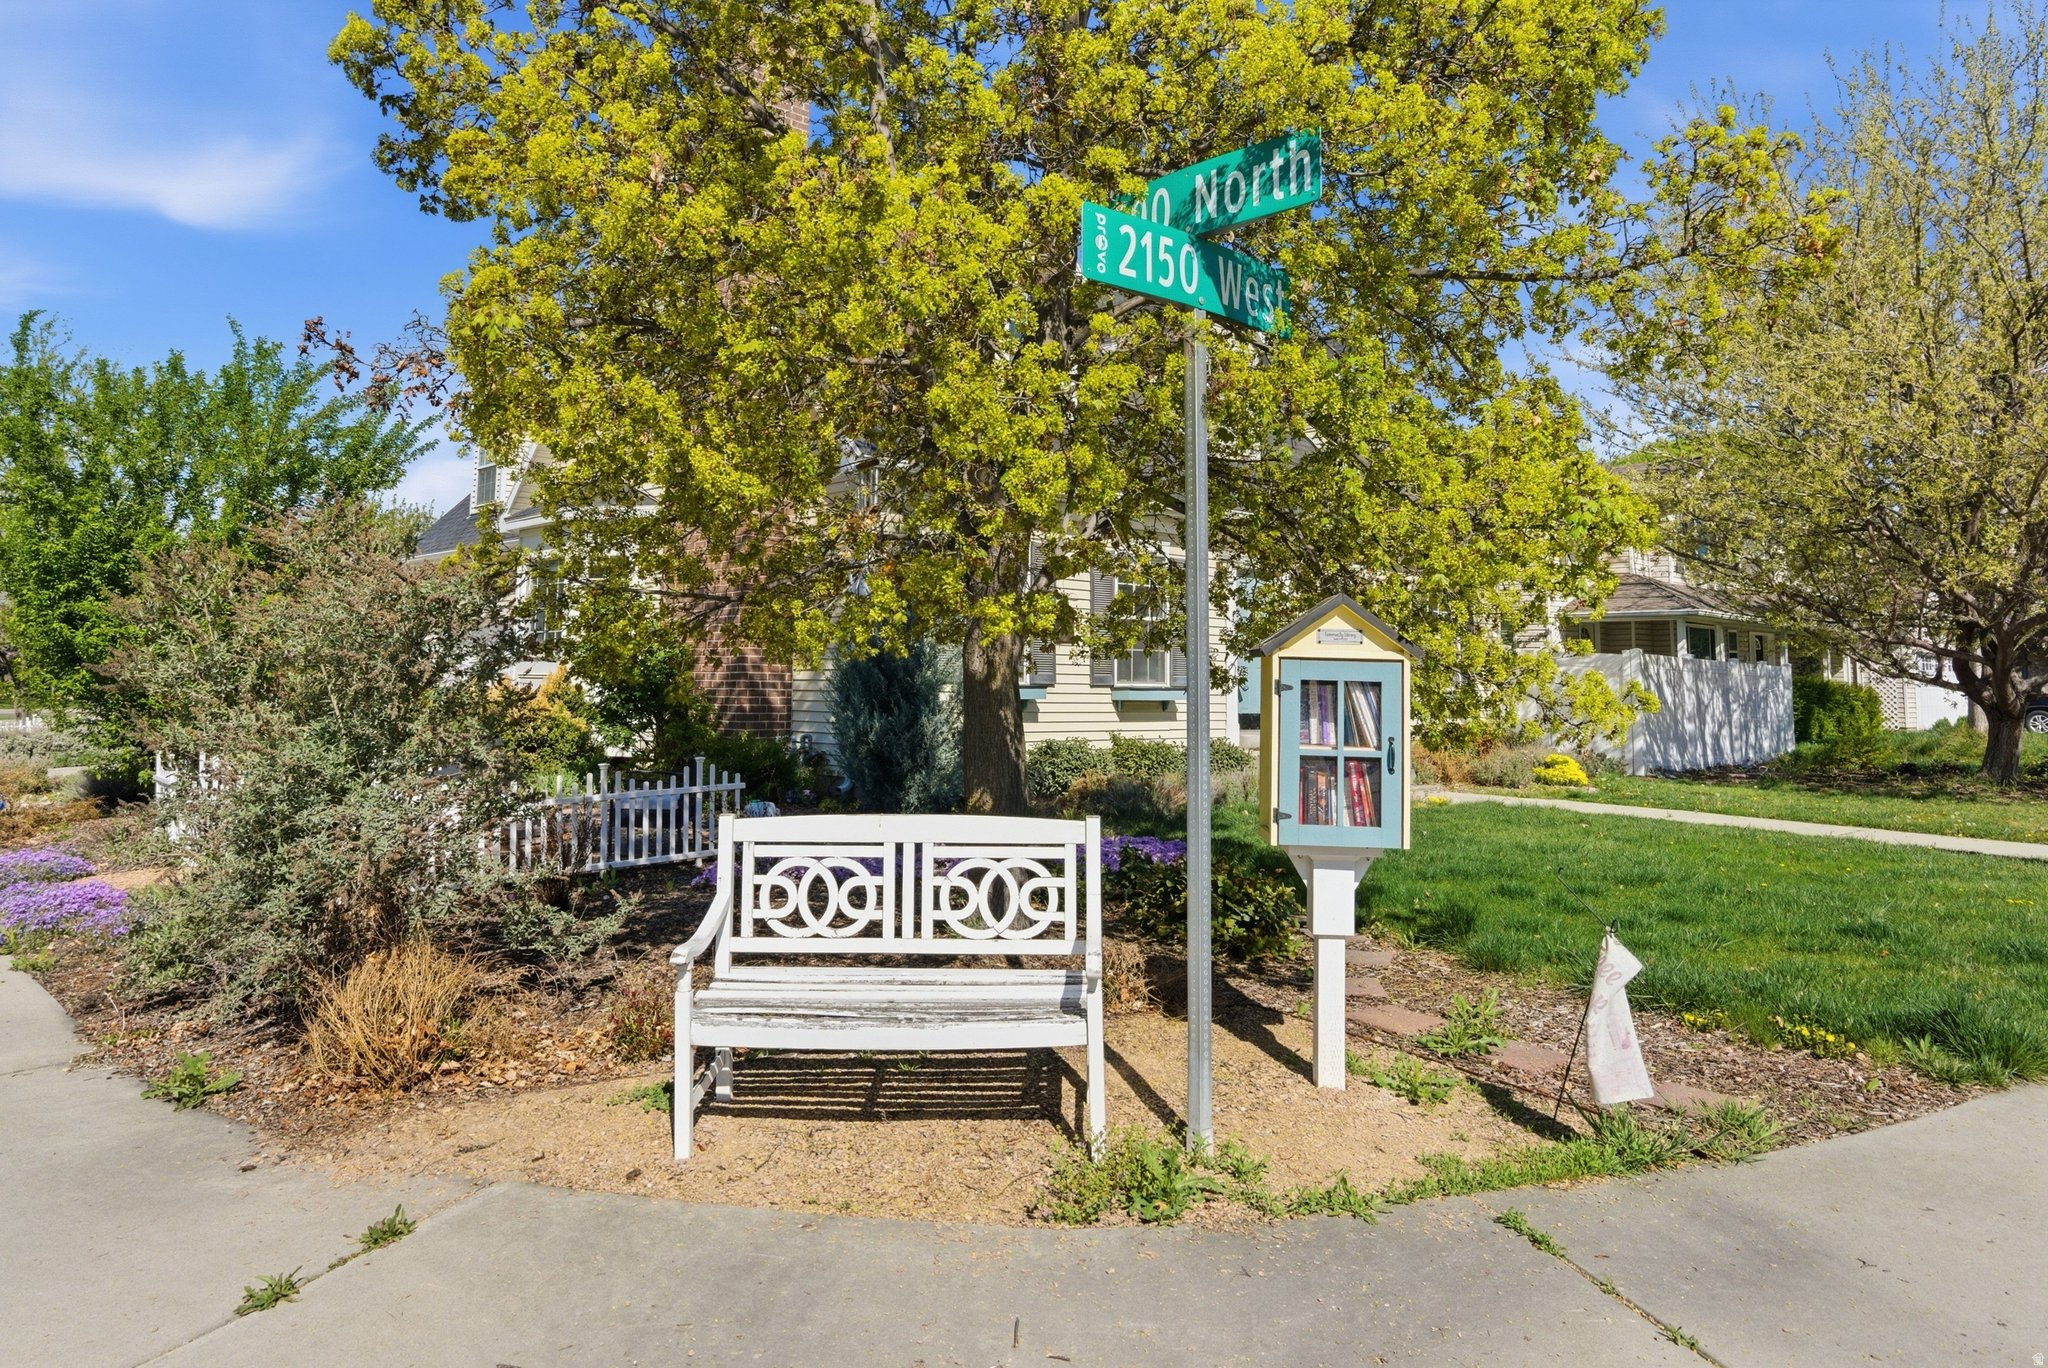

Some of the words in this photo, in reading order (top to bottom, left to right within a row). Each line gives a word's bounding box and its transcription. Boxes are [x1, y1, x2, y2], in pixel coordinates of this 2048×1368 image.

[1195, 139, 1312, 223] North
[1095, 212, 1108, 274] provo
[1119, 224, 1199, 294] 2150
[1218, 255, 1284, 324] West
